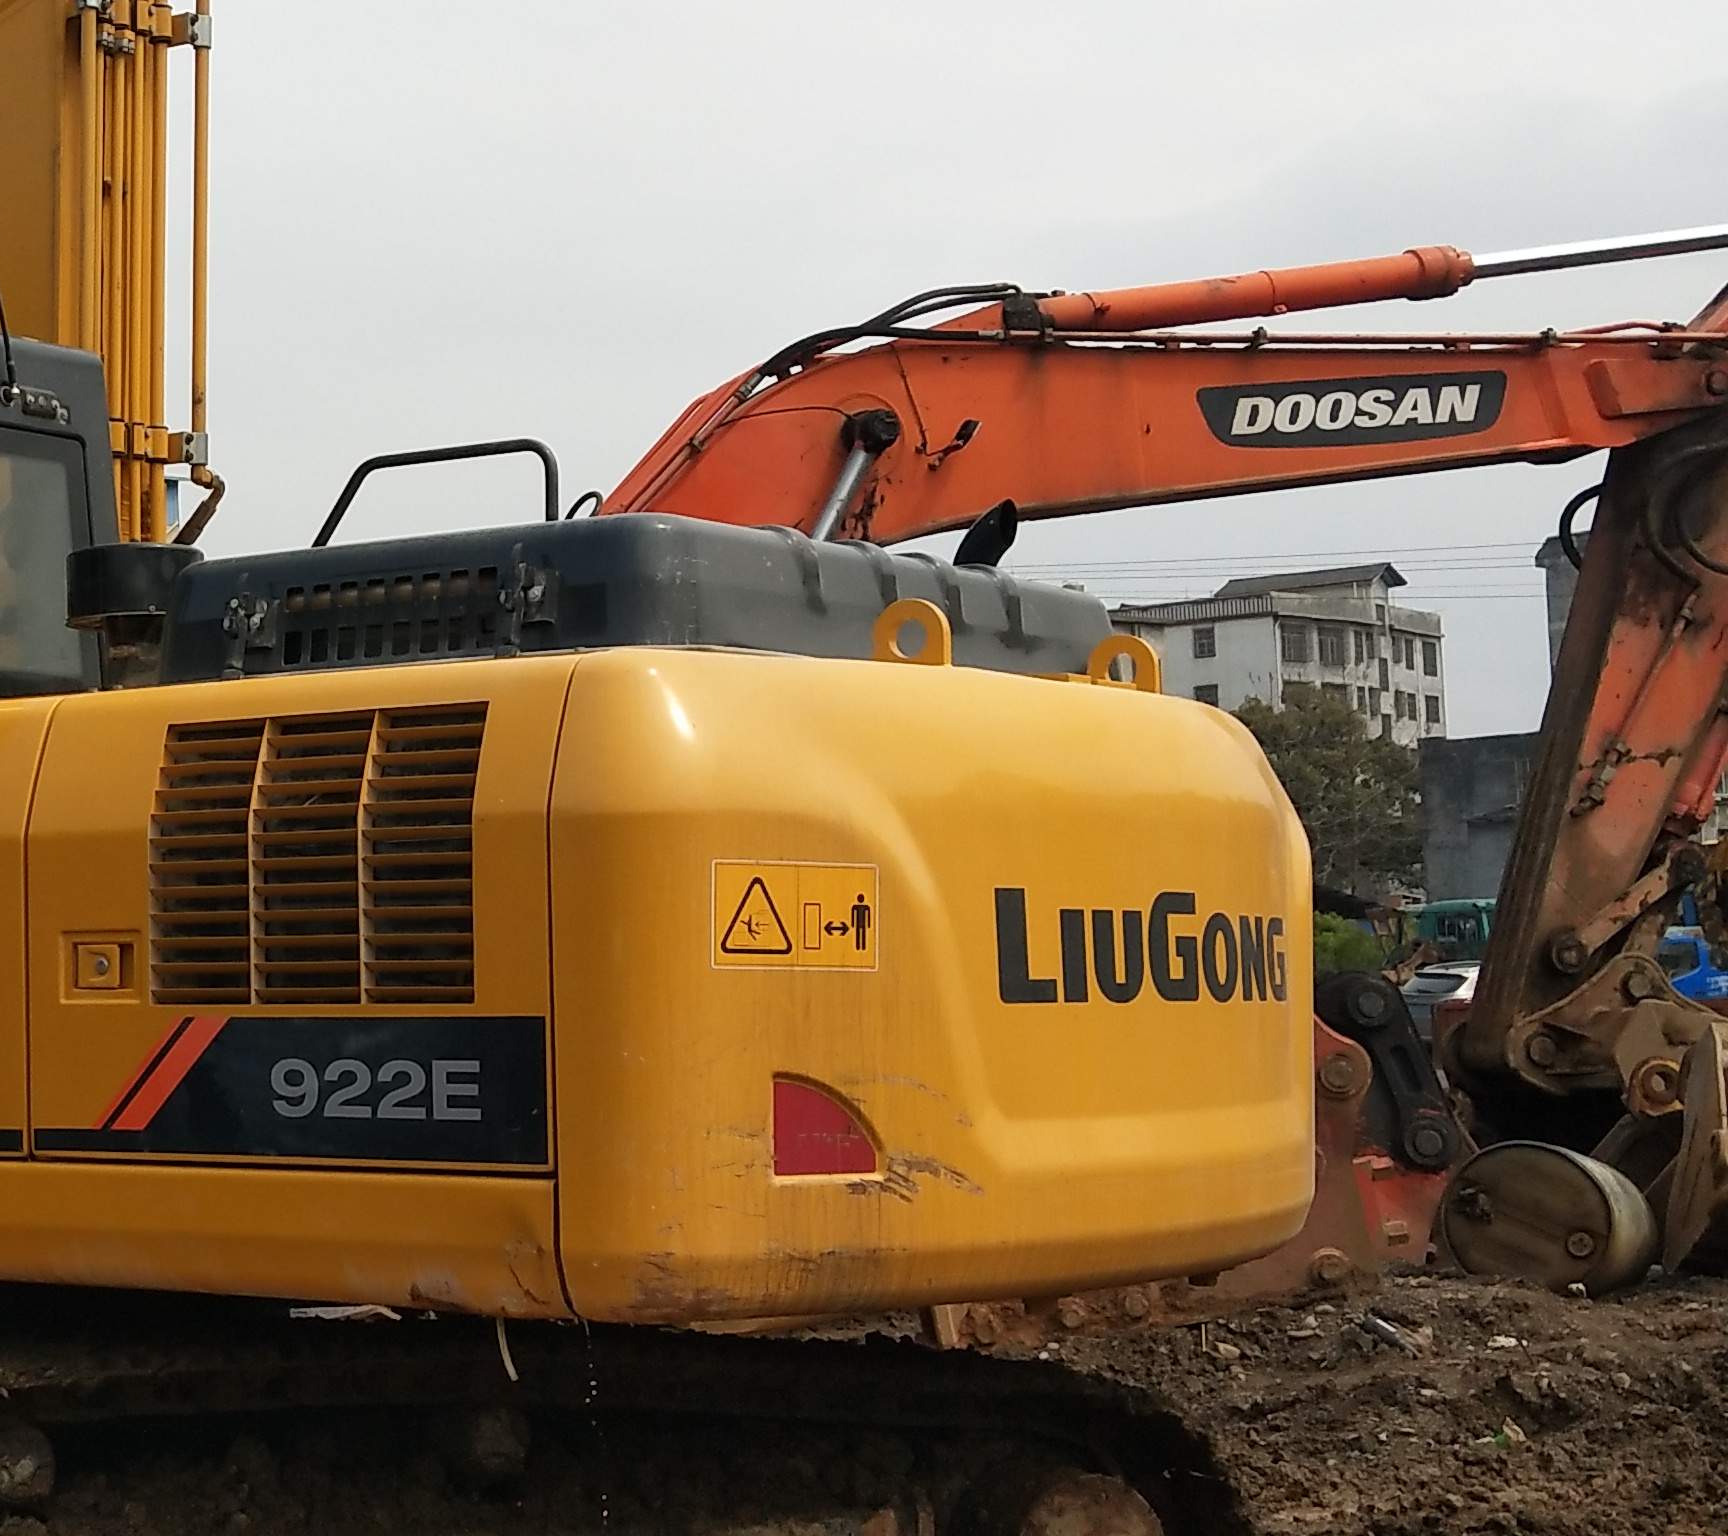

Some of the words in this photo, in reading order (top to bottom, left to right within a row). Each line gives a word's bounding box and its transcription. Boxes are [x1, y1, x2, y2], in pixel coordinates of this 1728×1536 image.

[1230, 384, 1481, 436] DOOSAN
[994, 887, 1287, 1004] LIUGONG
[269, 1058, 483, 1121] 922E
